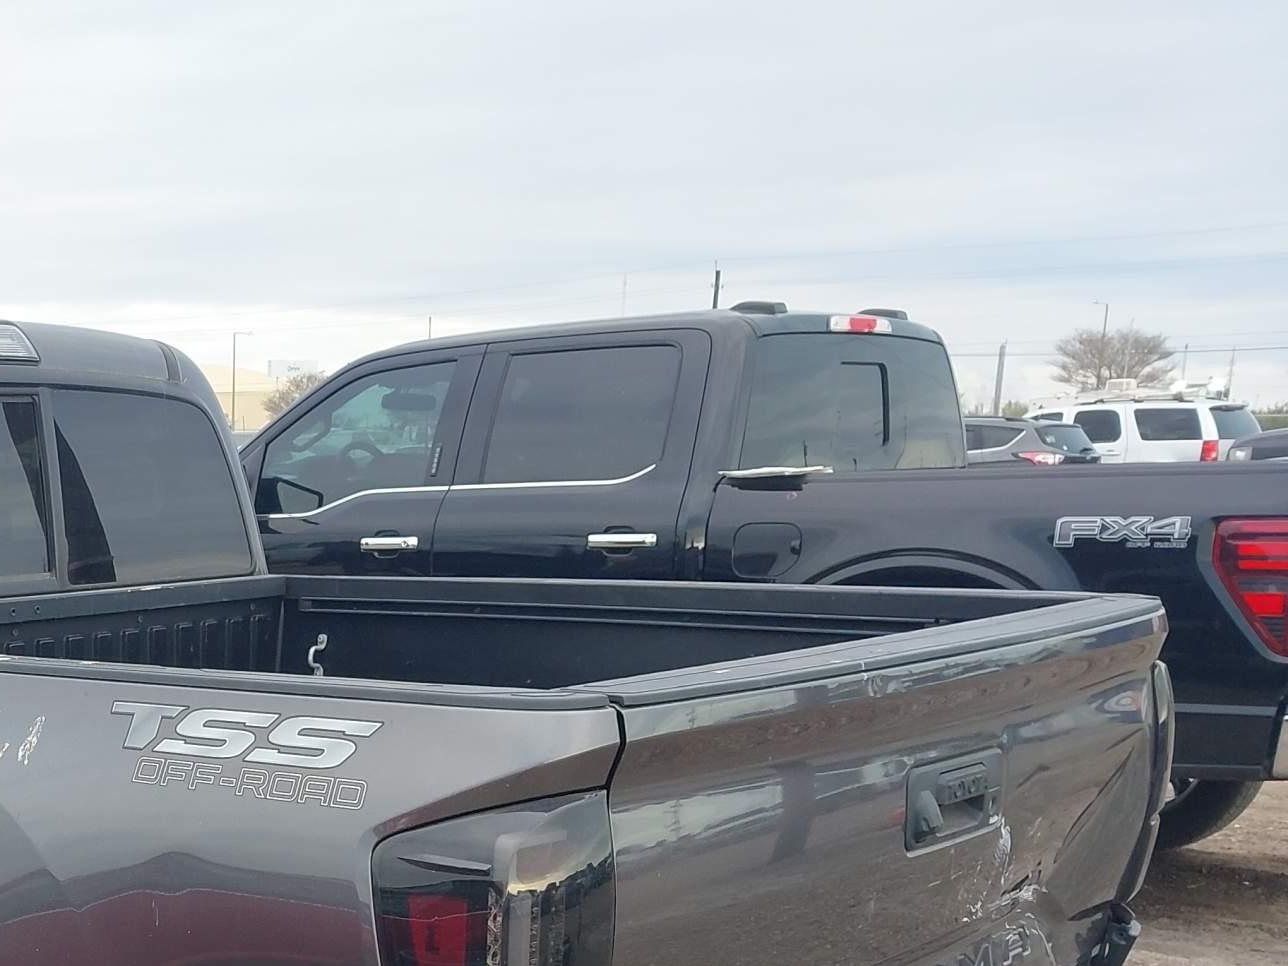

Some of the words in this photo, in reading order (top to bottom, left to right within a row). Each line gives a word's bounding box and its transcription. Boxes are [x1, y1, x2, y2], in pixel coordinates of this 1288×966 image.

[1053, 516, 1192, 548] FX4
[111, 700, 384, 770] TSS
[131, 755, 368, 810] OFF-ROAD
